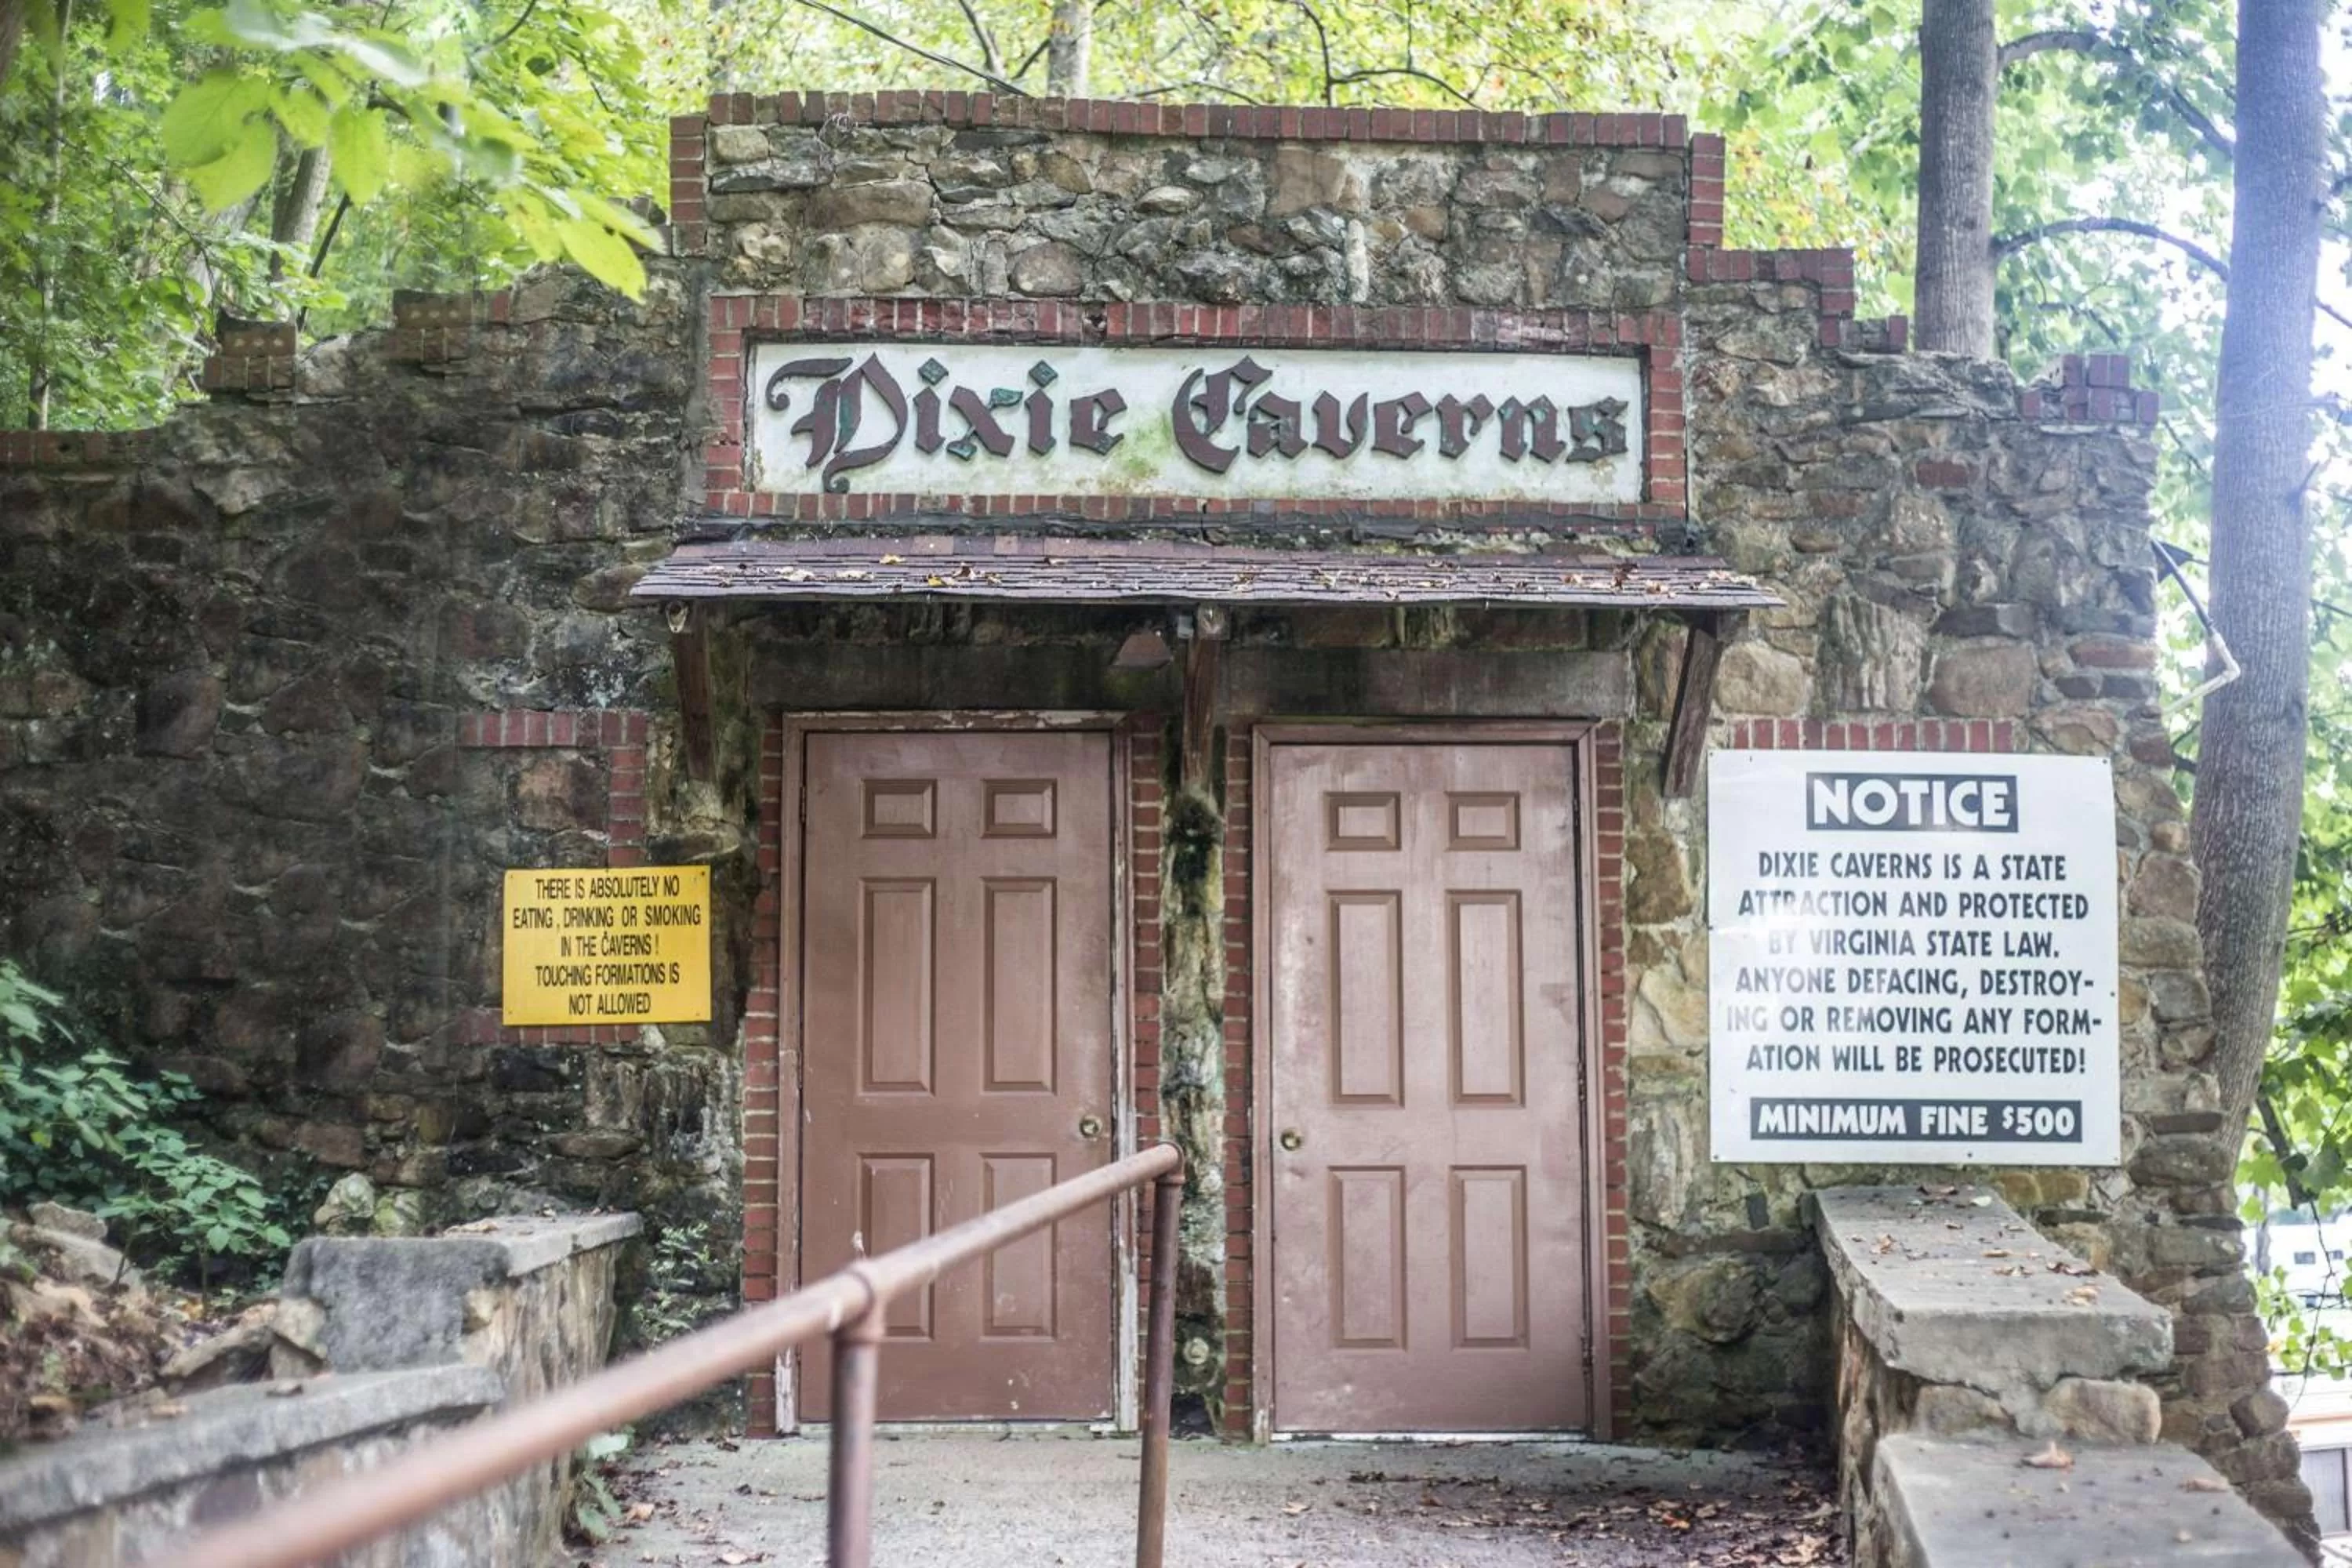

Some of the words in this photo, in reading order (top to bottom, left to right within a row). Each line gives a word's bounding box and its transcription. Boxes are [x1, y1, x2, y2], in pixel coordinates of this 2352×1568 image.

[766, 352, 1126, 494] Dixie
[1171, 355, 1630, 474] Caverns
[1812, 779, 2011, 827] NOTICE
[1759, 851, 1818, 877] DIXIE
[1831, 852, 1933, 879] CAVERNS
[1944, 854, 1961, 879] IS
[1973, 855, 1990, 880] A
[2001, 855, 2067, 880] STATE
[536, 878, 570, 899] THERE
[575, 878, 584, 898] IS
[590, 877, 659, 898] ABSOLUTELY
[664, 876, 680, 896] NO
[564, 906, 613, 927] DRINKING
[622, 906, 637, 927] OR
[645, 905, 701, 926] SMOKING
[1738, 890, 1887, 916] ATTRACTION
[1899, 891, 1947, 917] AND
[1960, 892, 2089, 920] PROTECTED
[561, 937, 571, 956] IN
[576, 936, 596, 956] THE
[1768, 929, 1795, 954] BY
[1809, 930, 1916, 956] VIRGINIA
[1927, 931, 1992, 956] STATE
[2004, 932, 2060, 958] LAW.
[536, 965, 591, 986] TOUCHING
[596, 964, 665, 985] FORMATIONS
[670, 963, 680, 983] IS
[1735, 967, 1835, 993] ANYONE
[1848, 968, 1968, 999] DEFACING,
[1980, 970, 2094, 996] DESTROY-
[569, 994, 592, 1014] NOT
[597, 993, 651, 1014] ALLOWED
[1726, 1006, 1768, 1032] ING
[1780, 1006, 1815, 1032] OR
[1828, 1007, 1951, 1033] REMOVING
[1963, 1008, 2013, 1034] ANY
[2024, 1009, 2102, 1035] FORM-
[1746, 1045, 1820, 1071] ATION
[1832, 1046, 1883, 1072] WILL
[1896, 1047, 1922, 1072] BE
[1934, 1047, 2085, 1074] PROSECUTED!
[1758, 1105, 1907, 1135] MINIMUM
[1921, 1105, 1988, 1135] FINE
[2002, 1107, 2075, 1136] $500
